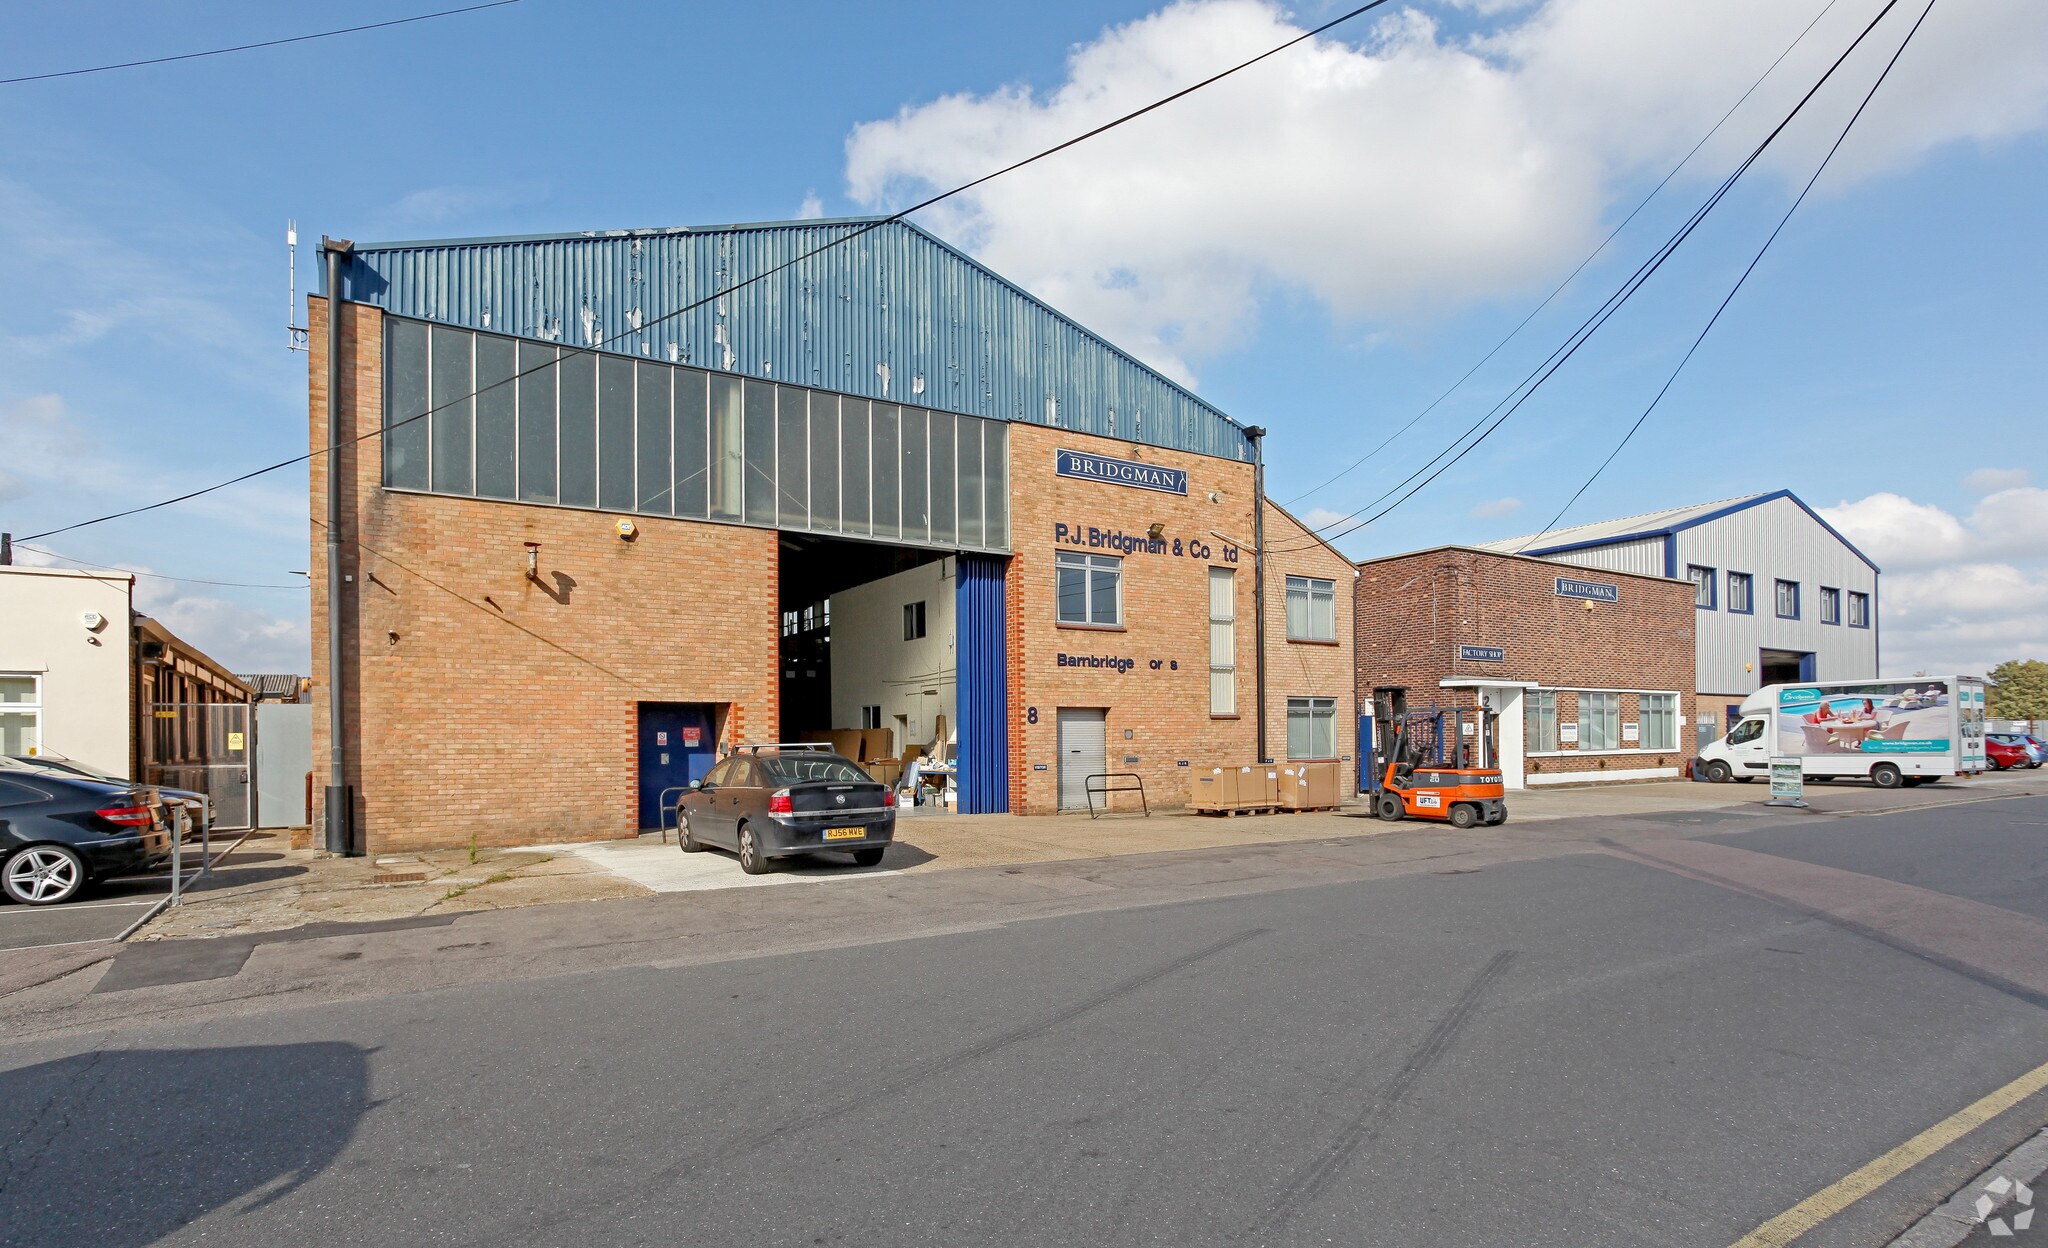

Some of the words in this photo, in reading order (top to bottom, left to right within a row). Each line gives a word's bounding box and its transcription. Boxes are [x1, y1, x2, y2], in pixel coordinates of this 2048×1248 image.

[1070, 457, 1175, 487] BRIDGMAN
[1089, 527, 1167, 555] Bridgman
[1172, 538, 1184, 557] &
[1189, 539, 1211, 560] Co
[1562, 582, 1612, 597] BRIDGMAN
[1462, 648, 1488, 657] FACTORY
[1027, 706, 1039, 725] 8
[828, 828, 848, 838] RJ56
